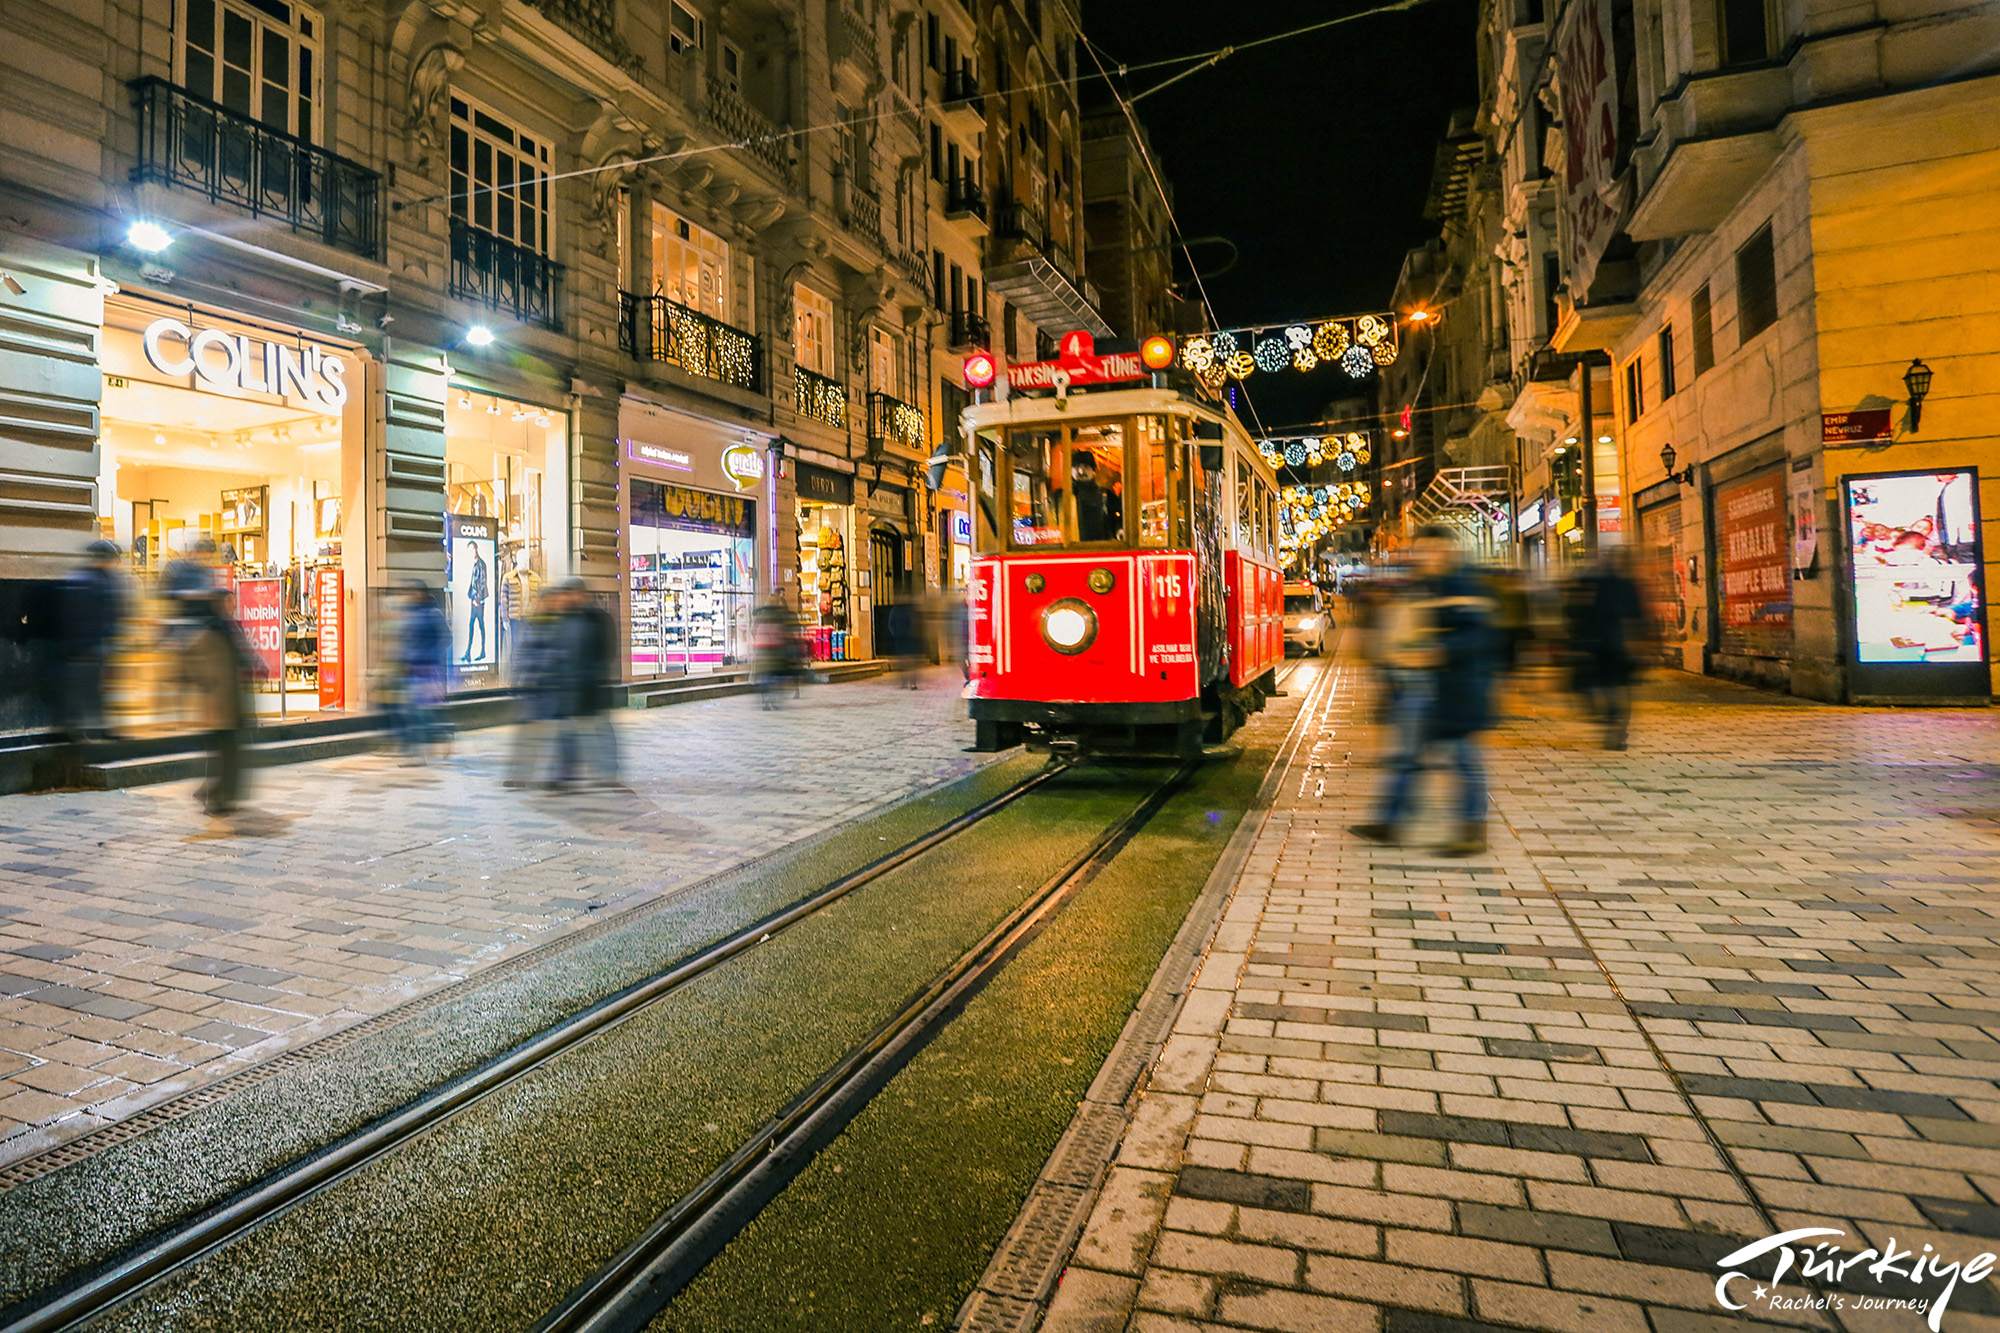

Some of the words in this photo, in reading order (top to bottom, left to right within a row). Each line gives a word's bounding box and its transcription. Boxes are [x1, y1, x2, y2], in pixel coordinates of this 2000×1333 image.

[143, 317, 348, 408] COLIN'S
[1824, 415, 1848, 425] EMİR
[1824, 424, 1863, 435] NEVRUZ
[733, 452, 765, 476] gratis
[460, 524, 488, 538] COLIN'S
[1157, 575, 1181, 598] 115
[243, 604, 279, 621] İNDİRİM
[321, 571, 339, 664] İNDİRİM
[244, 625, 280, 652] %50
